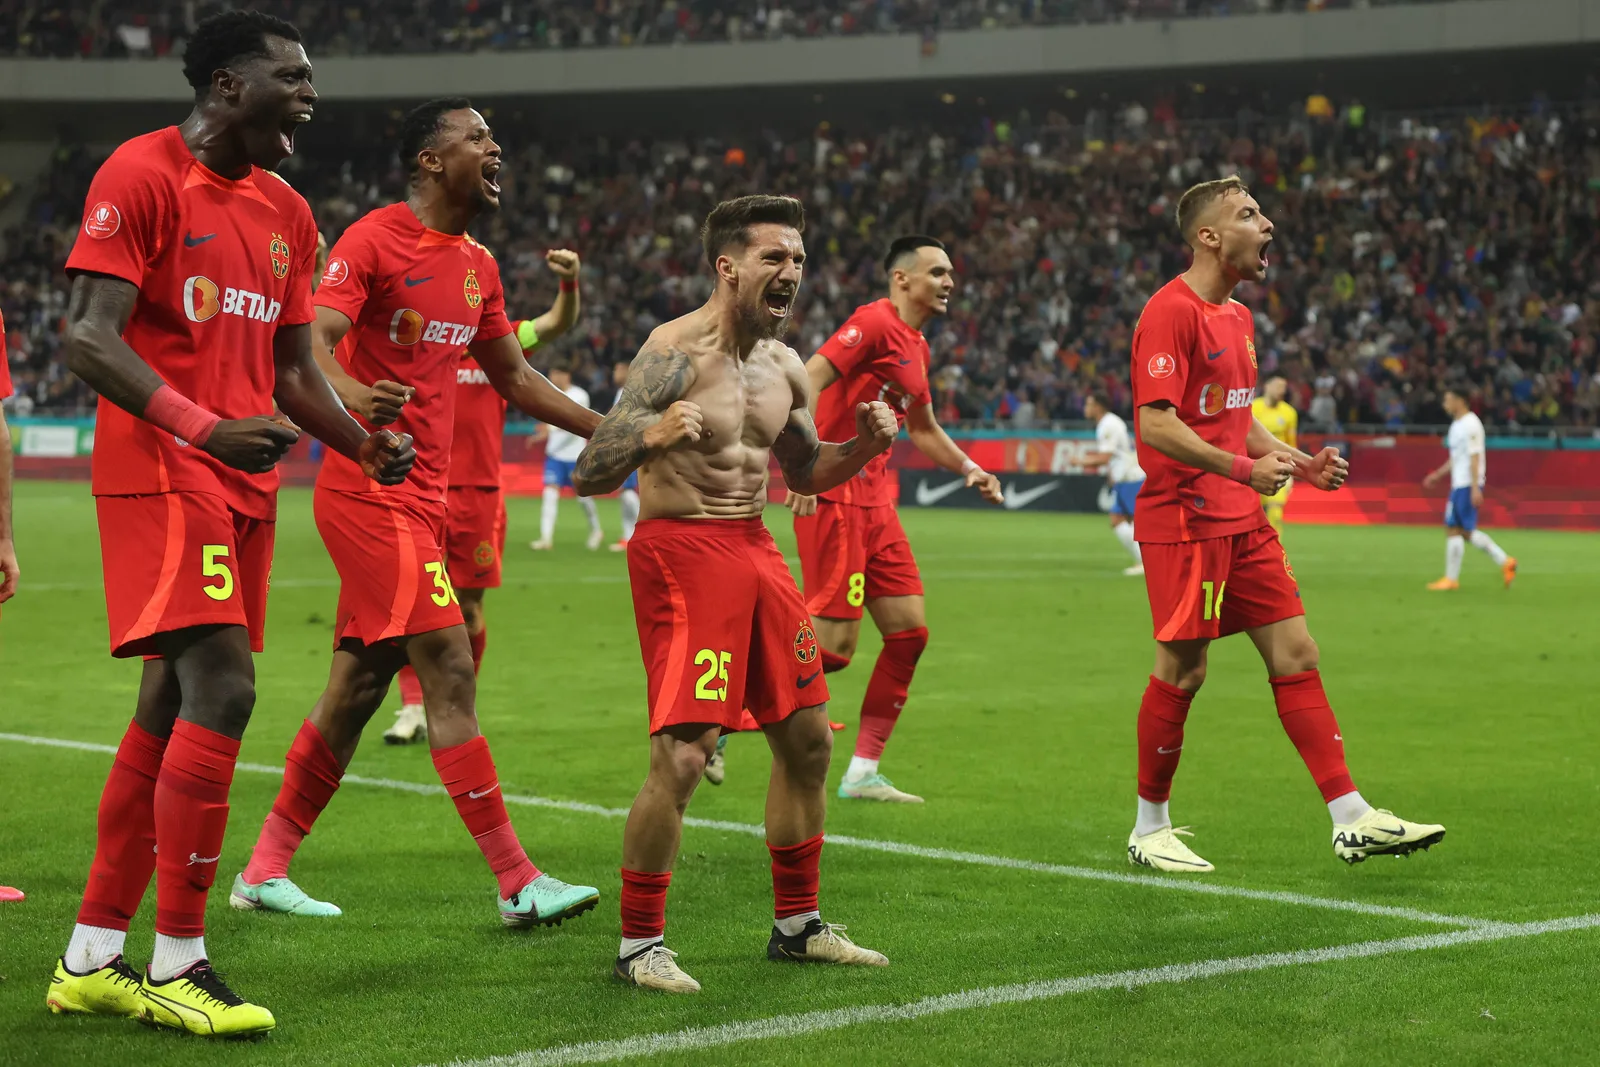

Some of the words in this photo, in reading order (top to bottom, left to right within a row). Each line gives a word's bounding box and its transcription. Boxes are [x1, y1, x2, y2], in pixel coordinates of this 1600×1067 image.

[1226, 387, 1256, 409] BETA
[202, 545, 234, 601] 5
[847, 572, 865, 607] 8
[694, 649, 732, 702] 25
